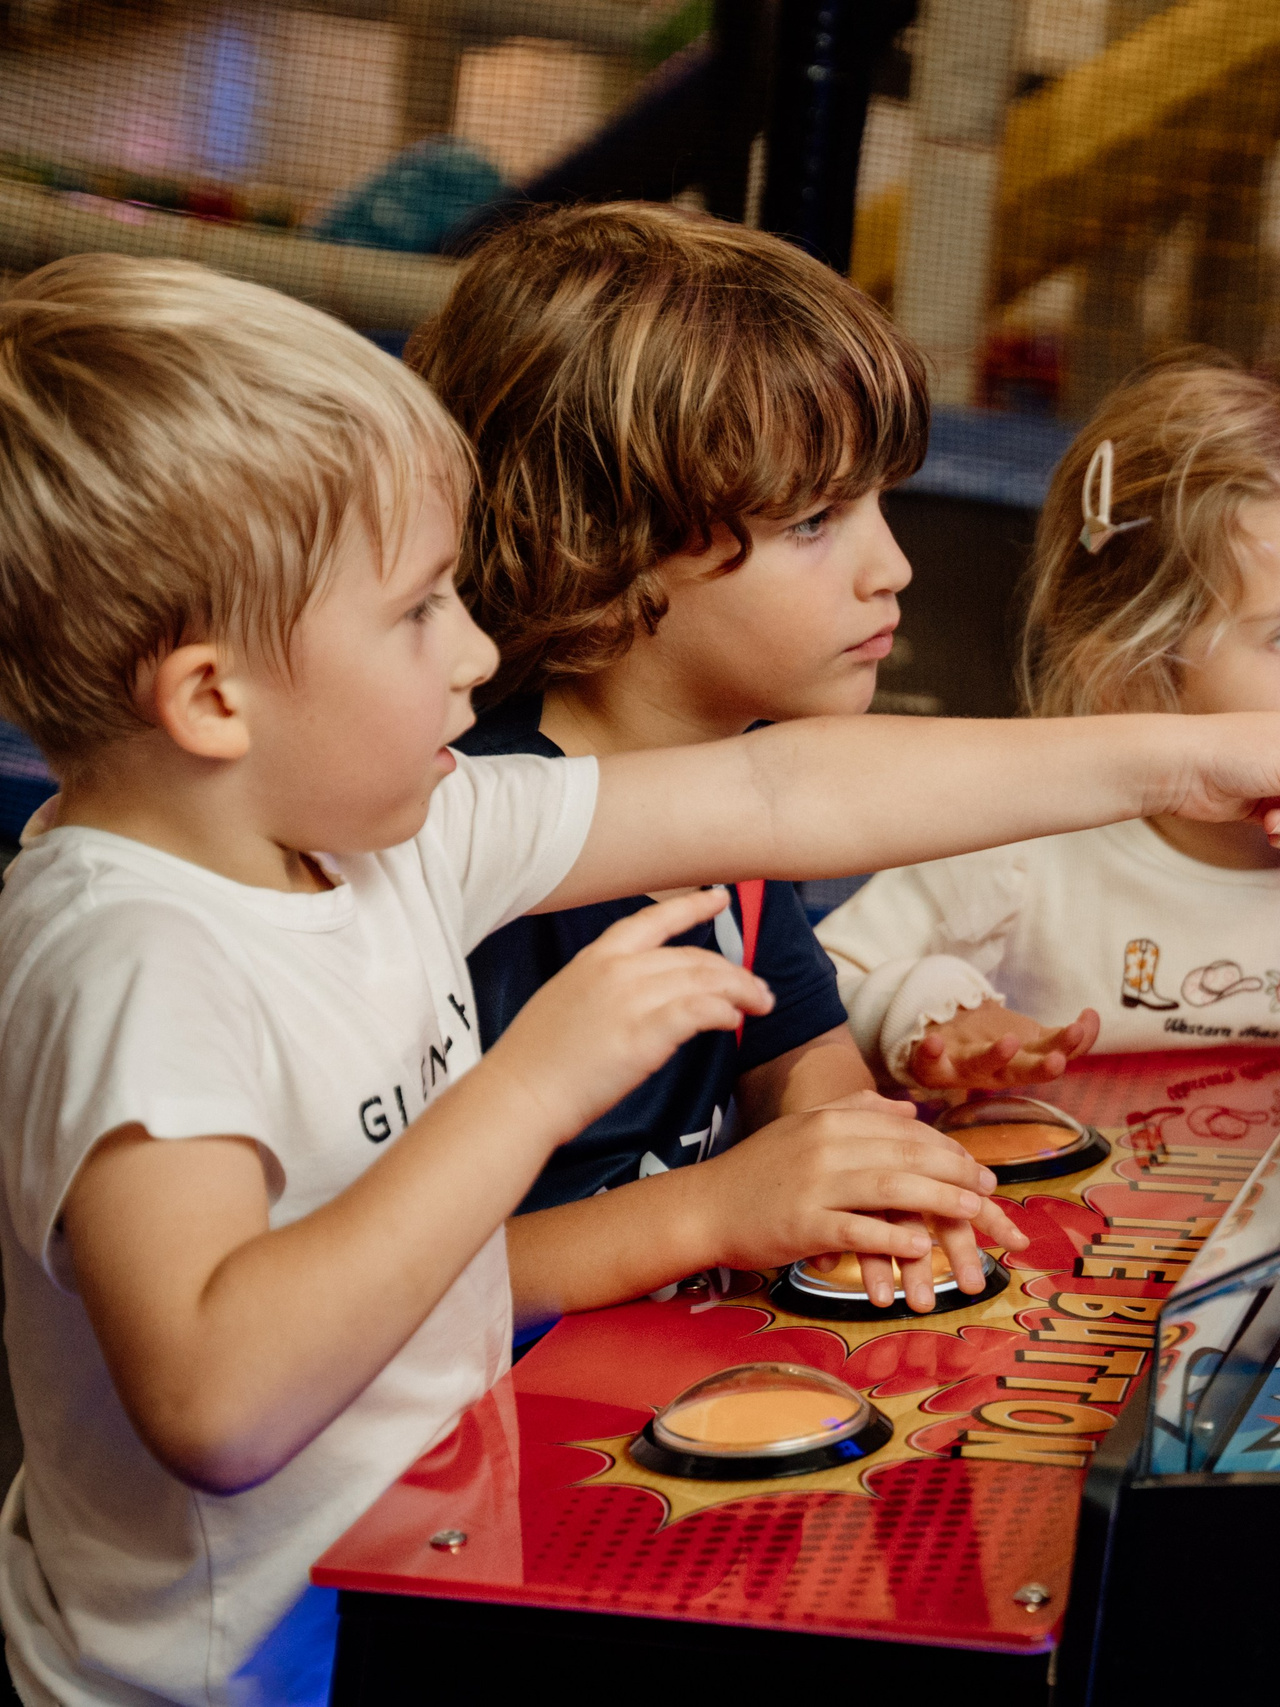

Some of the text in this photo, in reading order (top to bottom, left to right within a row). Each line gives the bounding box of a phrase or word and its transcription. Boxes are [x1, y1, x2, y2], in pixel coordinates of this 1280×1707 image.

[1129, 1143, 1264, 1202] HIT
[1073, 1216, 1222, 1284] THE
[952, 1292, 1166, 1467] BUTTON
